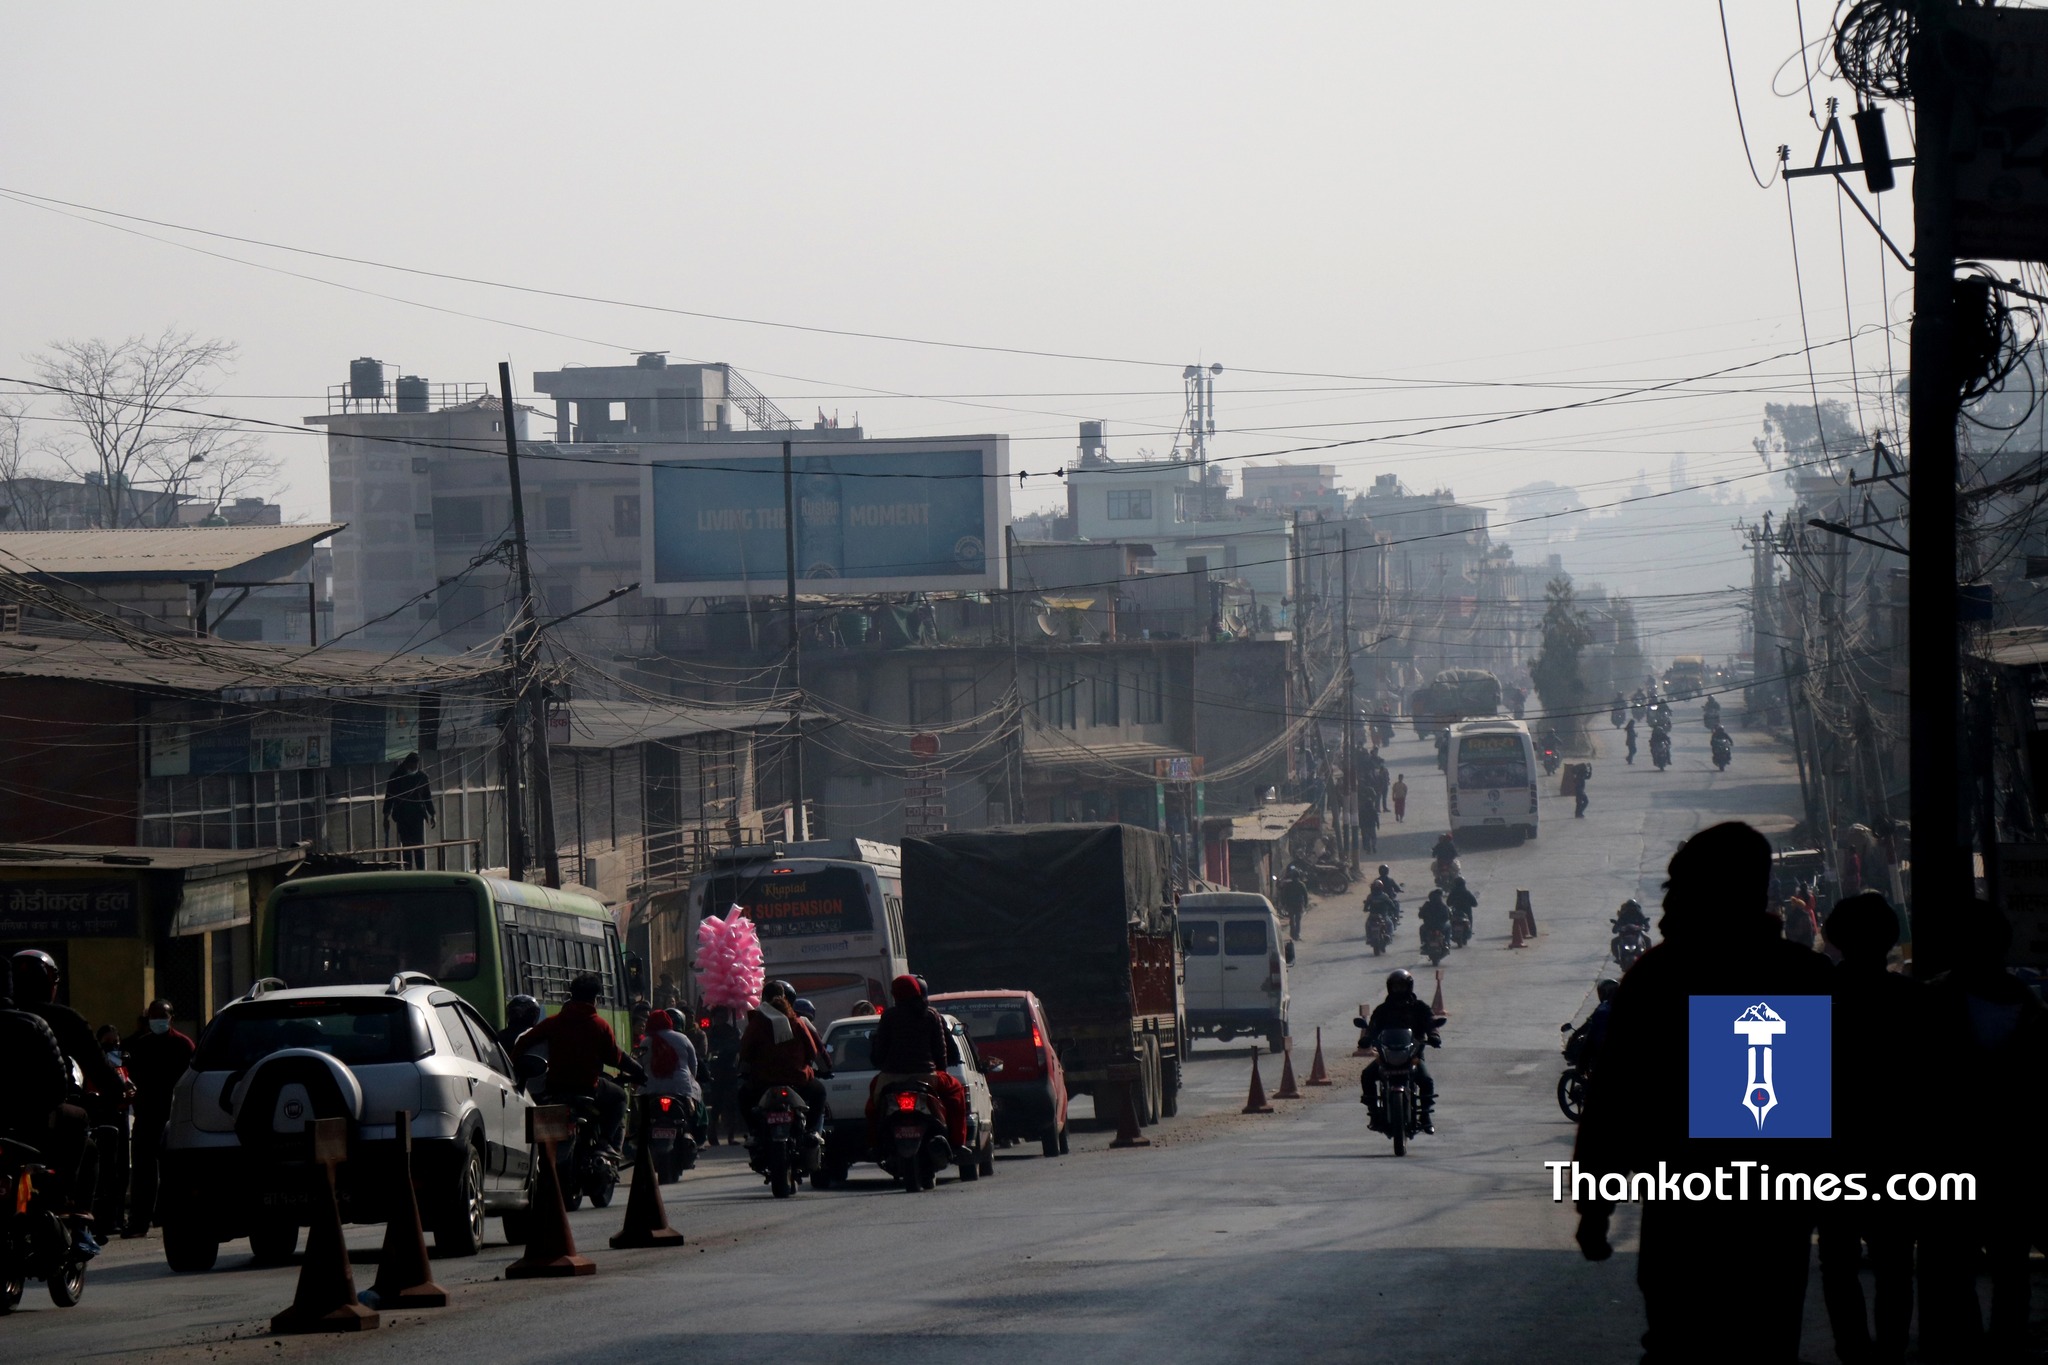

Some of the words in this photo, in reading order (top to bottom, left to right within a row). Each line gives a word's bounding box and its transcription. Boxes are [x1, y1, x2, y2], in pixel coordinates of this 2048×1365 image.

[697, 507, 752, 531] LIVING
[756, 507, 788, 530] THE
[849, 502, 930, 527] MOMENT
[907, 807, 943, 817] COFFEE
[9, 888, 89, 912] मेडीकल
[756, 899, 844, 920] SUSPENSION
